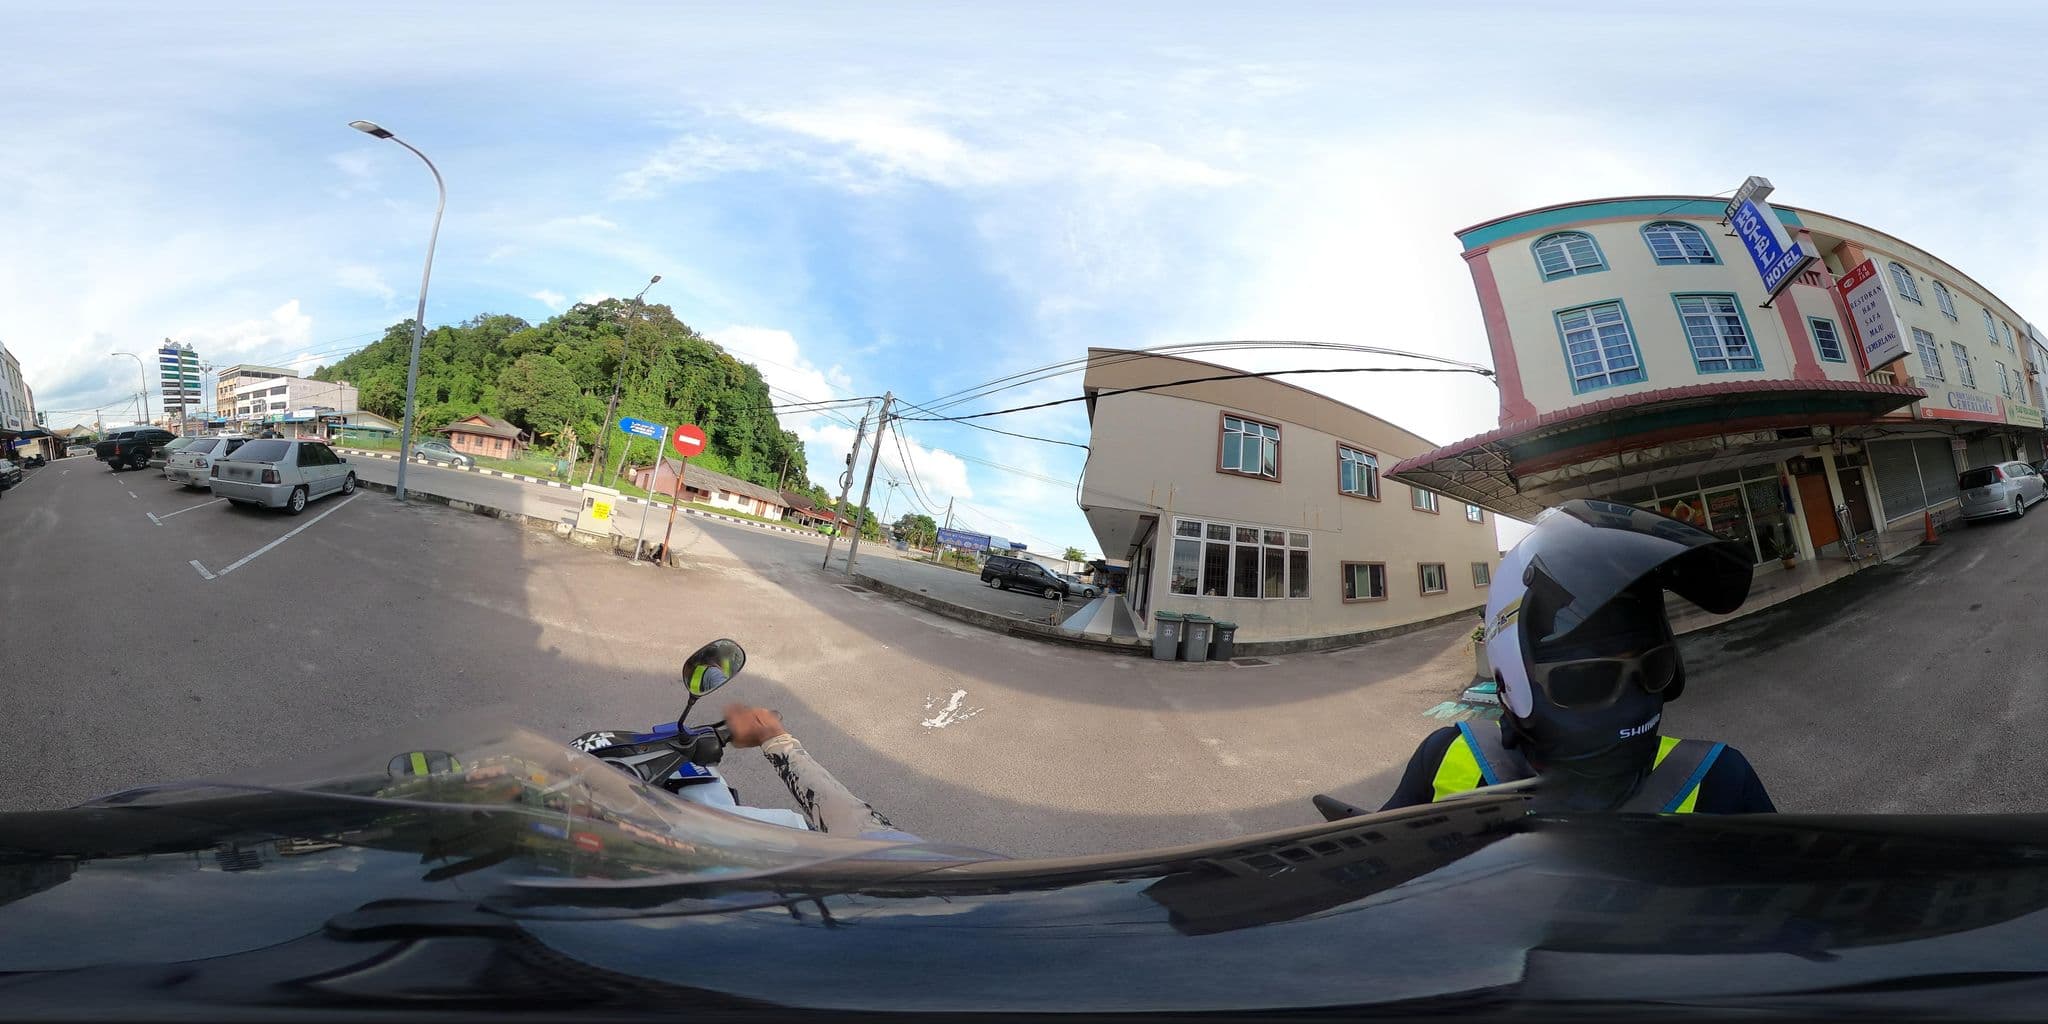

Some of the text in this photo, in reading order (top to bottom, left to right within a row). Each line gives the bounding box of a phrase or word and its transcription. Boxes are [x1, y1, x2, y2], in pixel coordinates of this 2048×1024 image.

[1727, 182, 1754, 217] SWEET
[1736, 205, 1775, 269] HOTEL
[1766, 250, 1800, 287] HOTEL
[1850, 286, 1882, 310] RESTORAN
[1866, 332, 1896, 354] CEMERLANG
